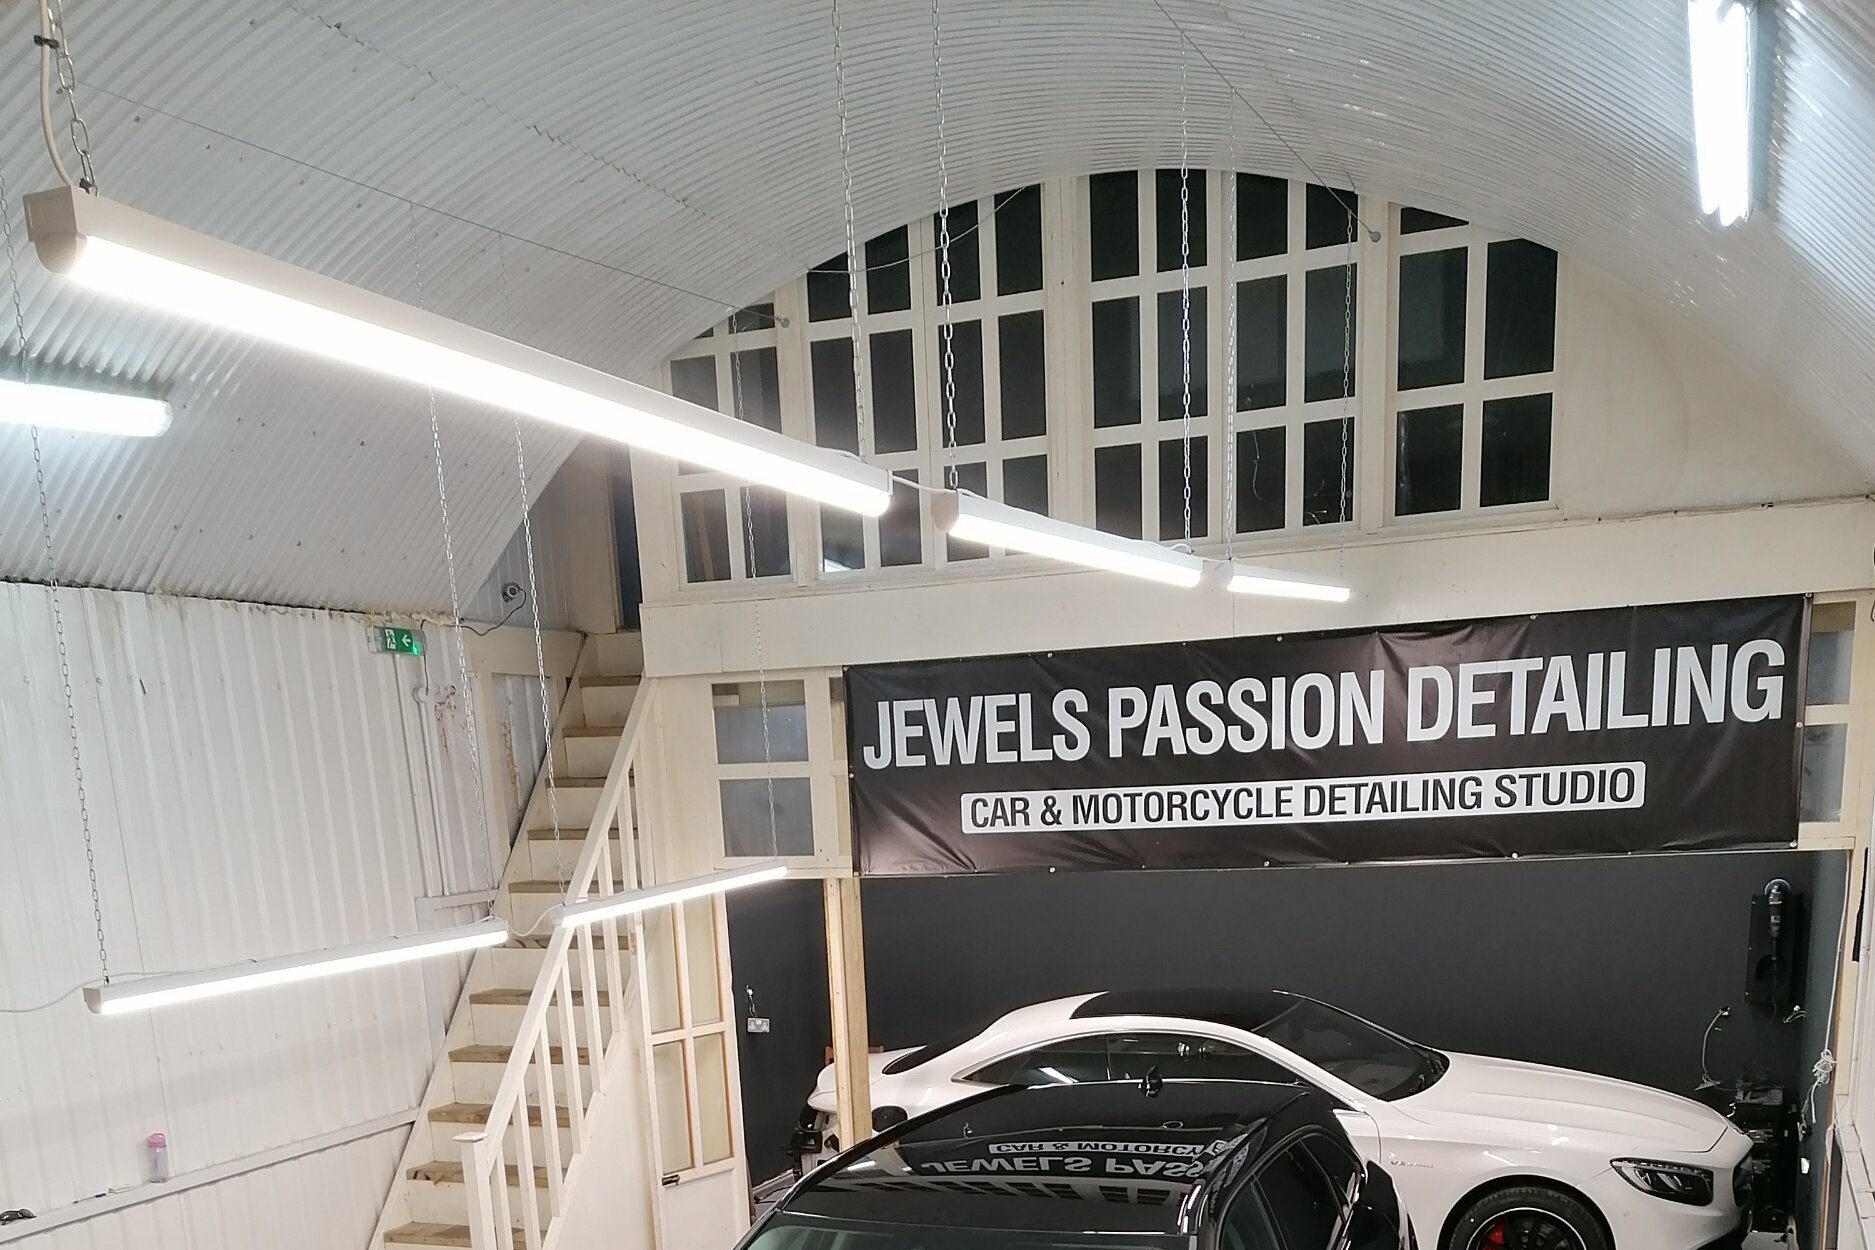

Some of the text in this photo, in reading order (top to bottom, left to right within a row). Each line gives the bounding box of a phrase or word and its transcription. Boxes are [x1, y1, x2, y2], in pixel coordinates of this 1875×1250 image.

[863, 638, 1786, 770] JEWELS PASSION DETAILING
[970, 766, 1636, 828] CAR & MOTORCYCLE DETAILING STUDIO
